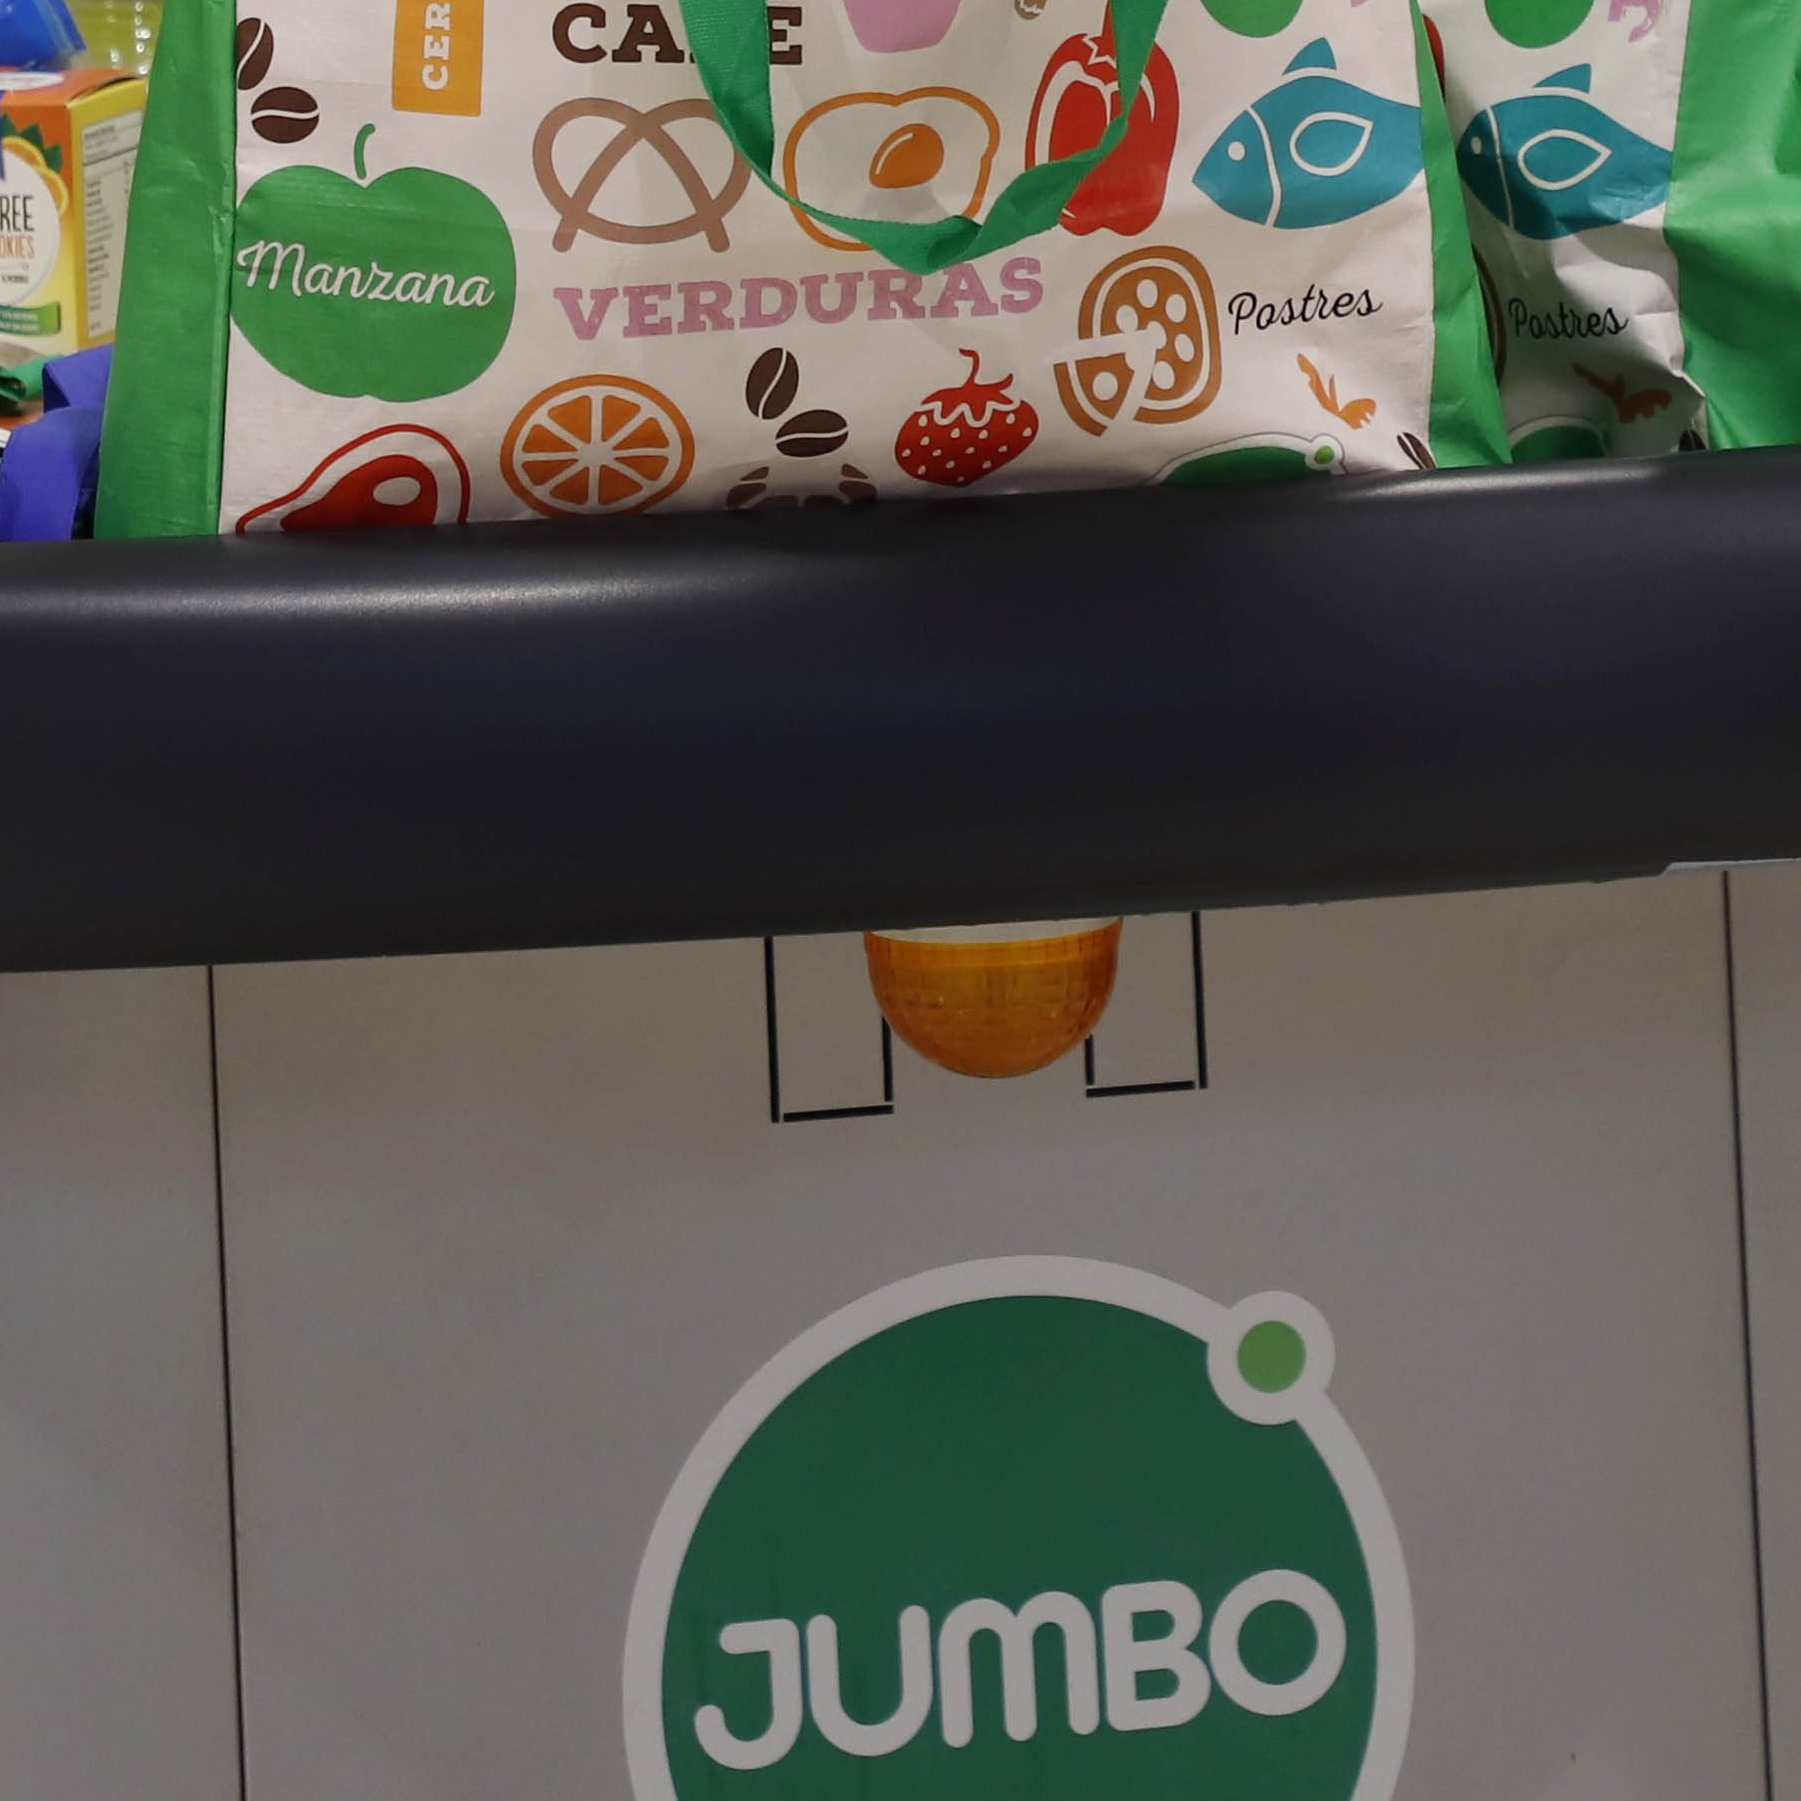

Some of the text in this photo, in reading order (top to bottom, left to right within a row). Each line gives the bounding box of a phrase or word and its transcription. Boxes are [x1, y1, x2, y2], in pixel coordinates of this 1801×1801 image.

[236, 239, 496, 309] Manzana
[553, 257, 1045, 341] VERDURAS
[1227, 283, 1384, 336] Postres
[1508, 297, 1629, 340] Postres
[693, 1568, 1348, 1771] JUMBO
